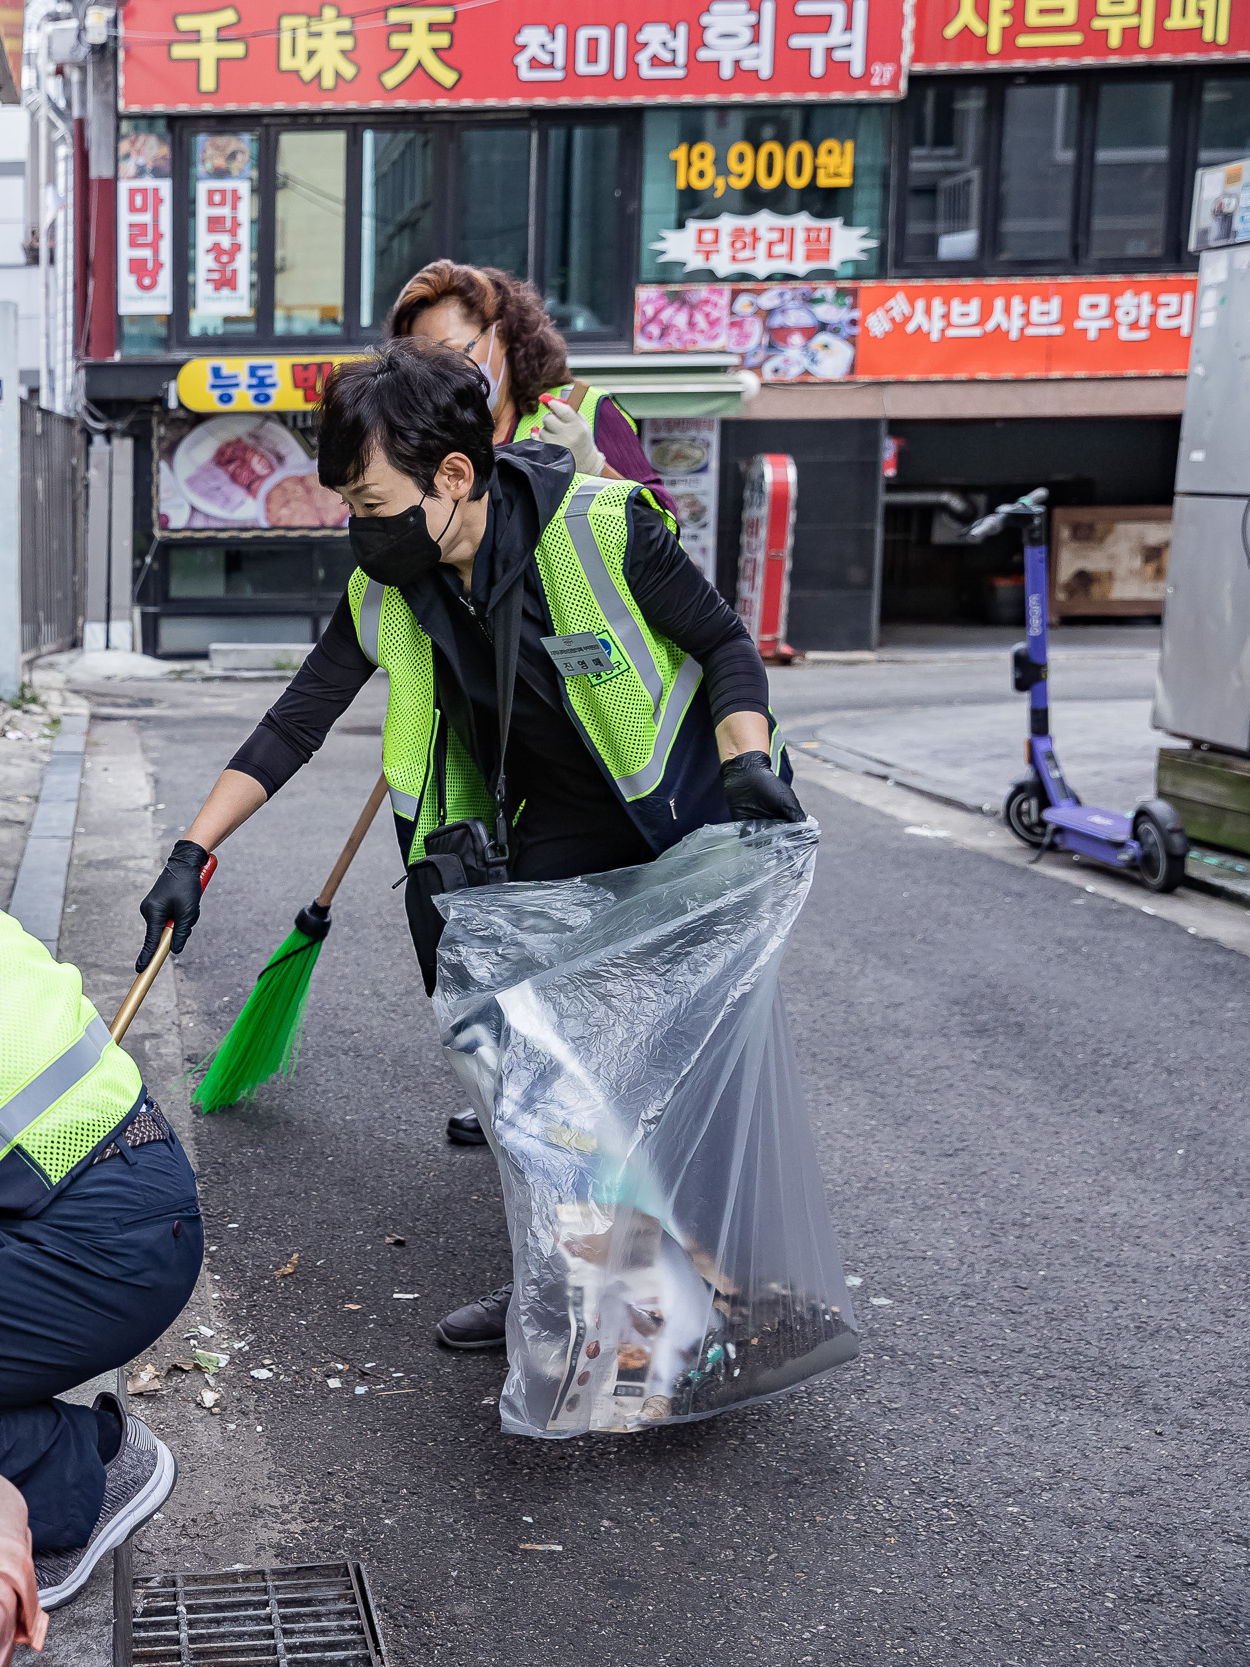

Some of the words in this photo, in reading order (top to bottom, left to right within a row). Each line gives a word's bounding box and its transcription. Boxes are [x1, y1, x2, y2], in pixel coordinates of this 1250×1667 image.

[170, 5, 461, 93] 千味天
[669, 138, 854, 198] 18,900원
[694, 226, 833, 264] 무한리필
[905, 296, 1063, 342] 샤브샤브
[210, 364, 277, 405] 능동
